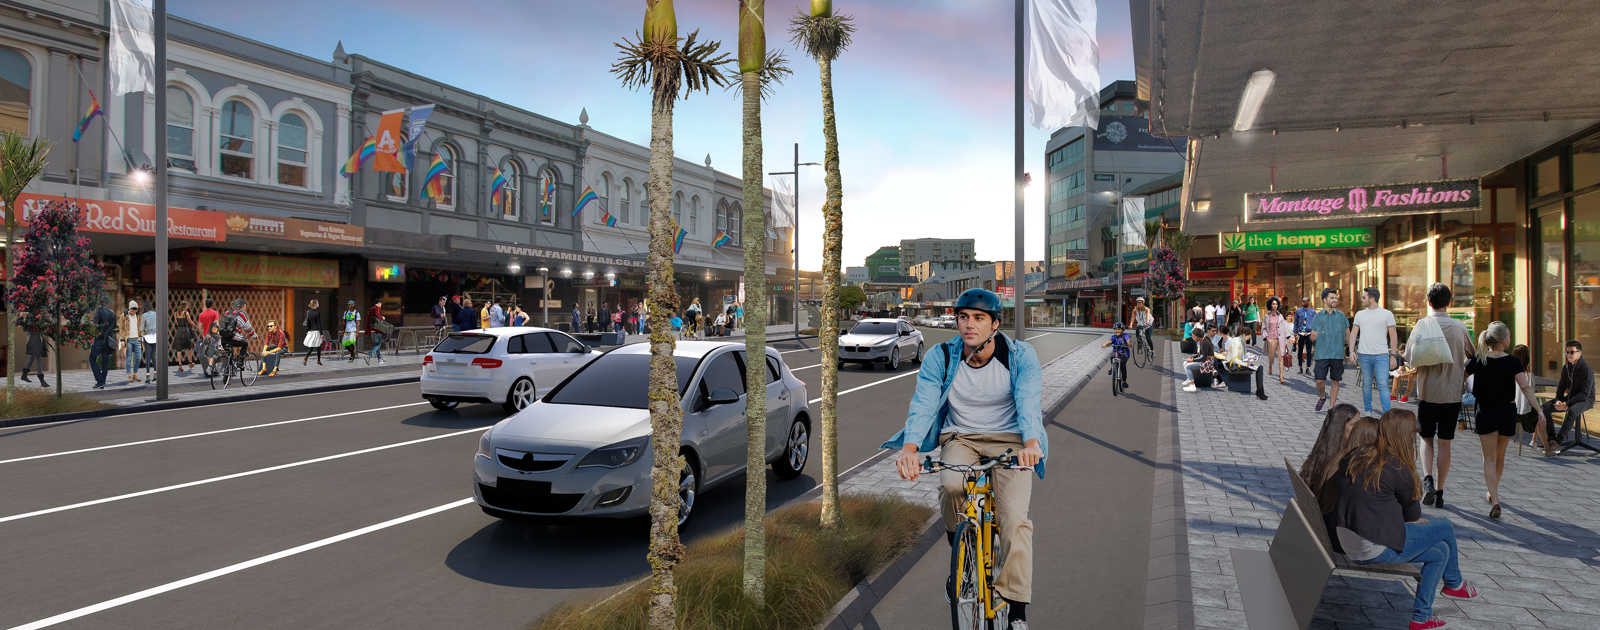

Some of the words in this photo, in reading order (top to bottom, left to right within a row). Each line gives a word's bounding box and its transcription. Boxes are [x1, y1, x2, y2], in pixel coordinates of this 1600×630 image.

[1256, 195, 1345, 214] Montage
[1372, 187, 1473, 207] Fashions
[86, 202, 124, 231] Red
[167, 217, 217, 239] Restaurant
[1249, 232, 1273, 247] the
[1277, 233, 1326, 247] hemp
[1330, 231, 1371, 244] store
